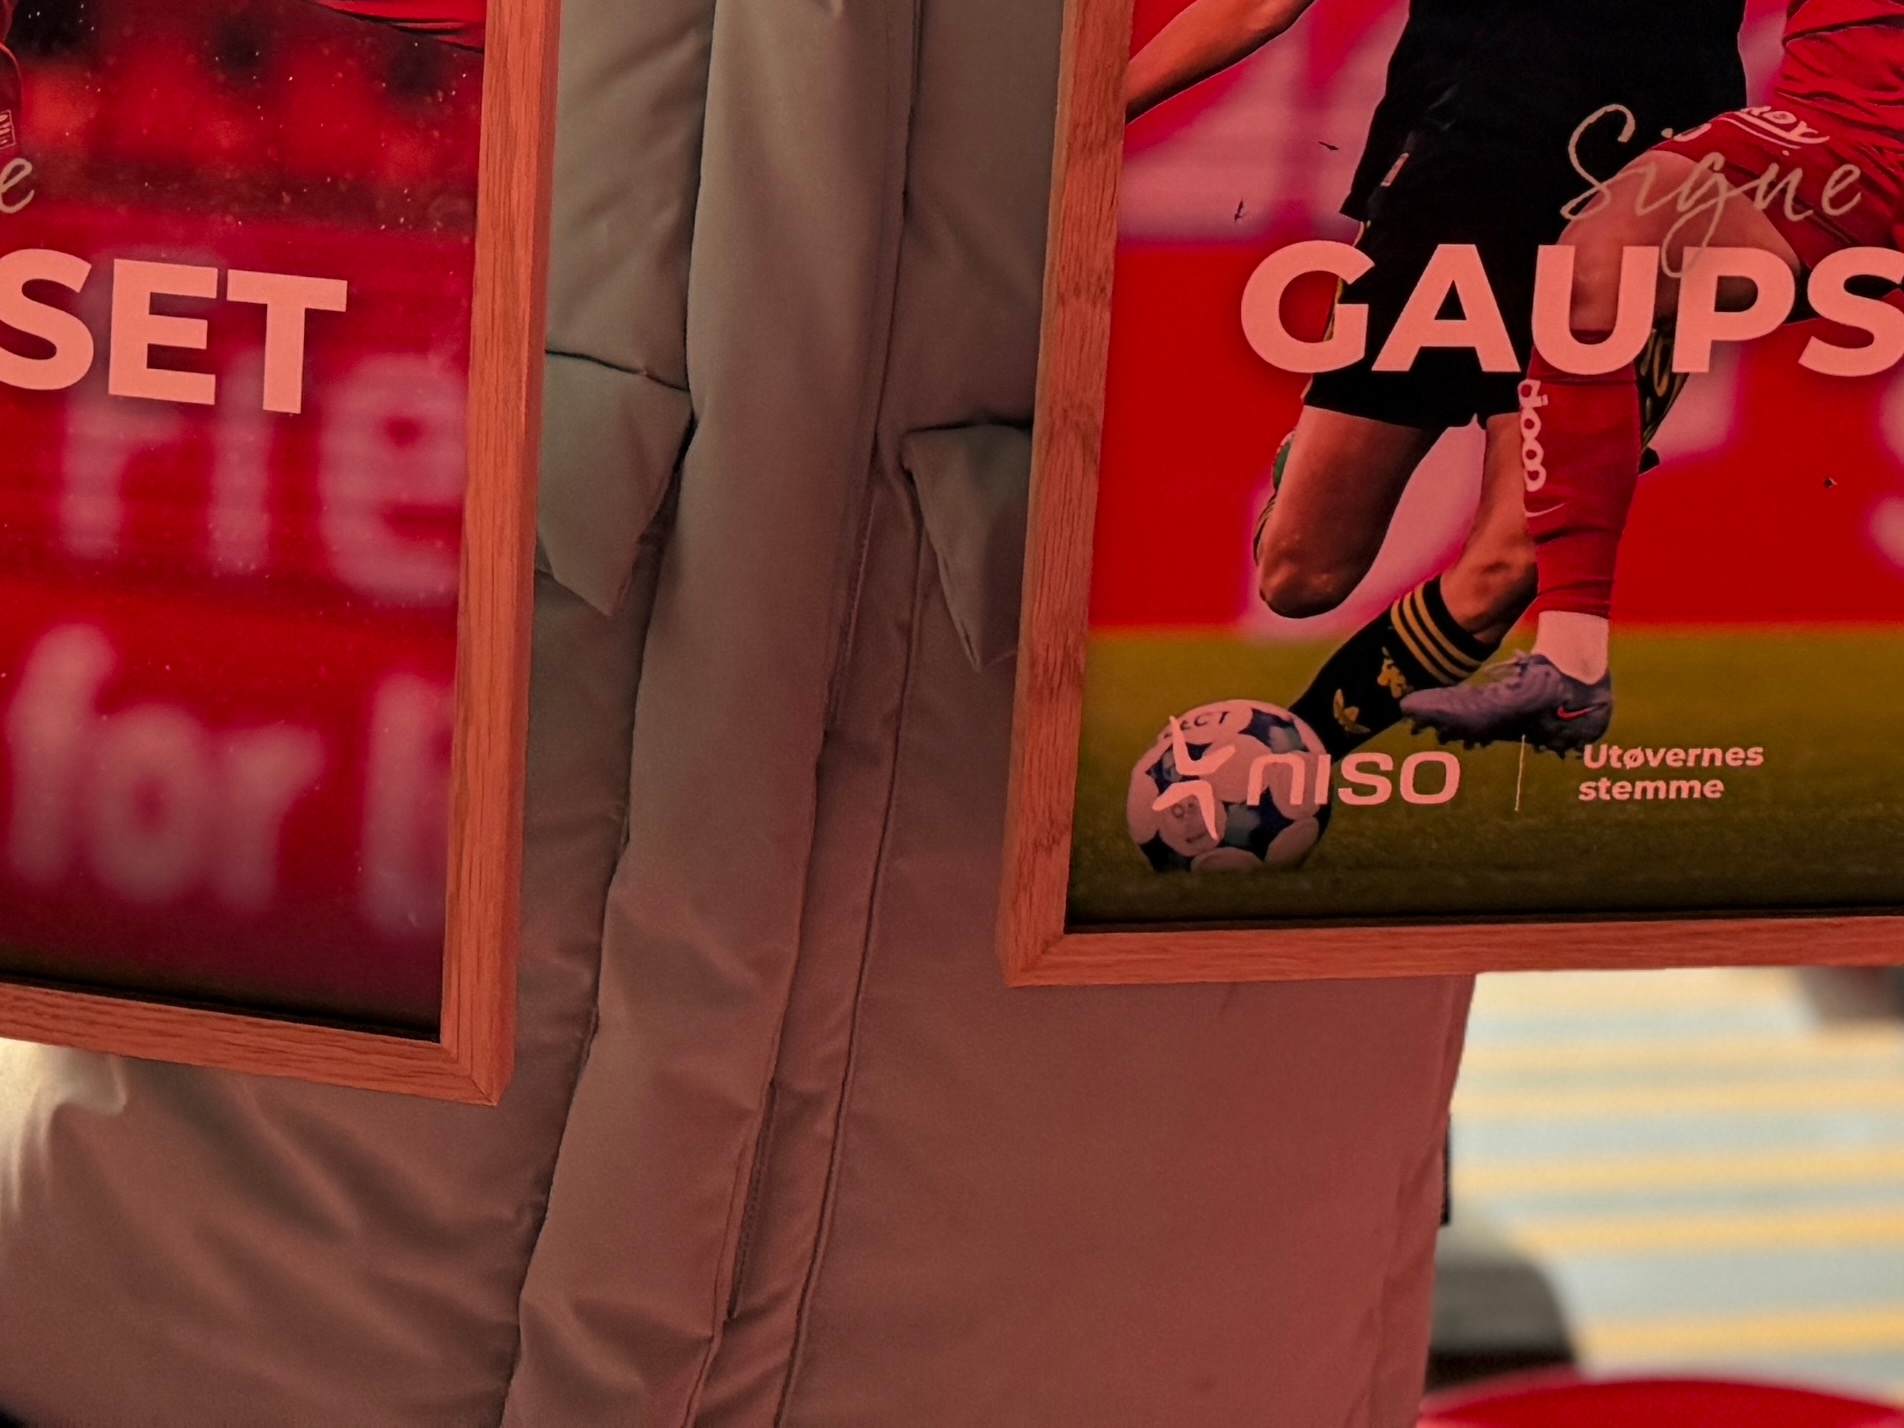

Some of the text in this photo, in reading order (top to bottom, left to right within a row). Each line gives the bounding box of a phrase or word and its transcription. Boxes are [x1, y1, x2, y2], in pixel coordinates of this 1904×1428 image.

[1559, 103, 1862, 279] Signe
[1582, 742, 1765, 770] Utøvernes
[1578, 776, 1725, 802] stemme
